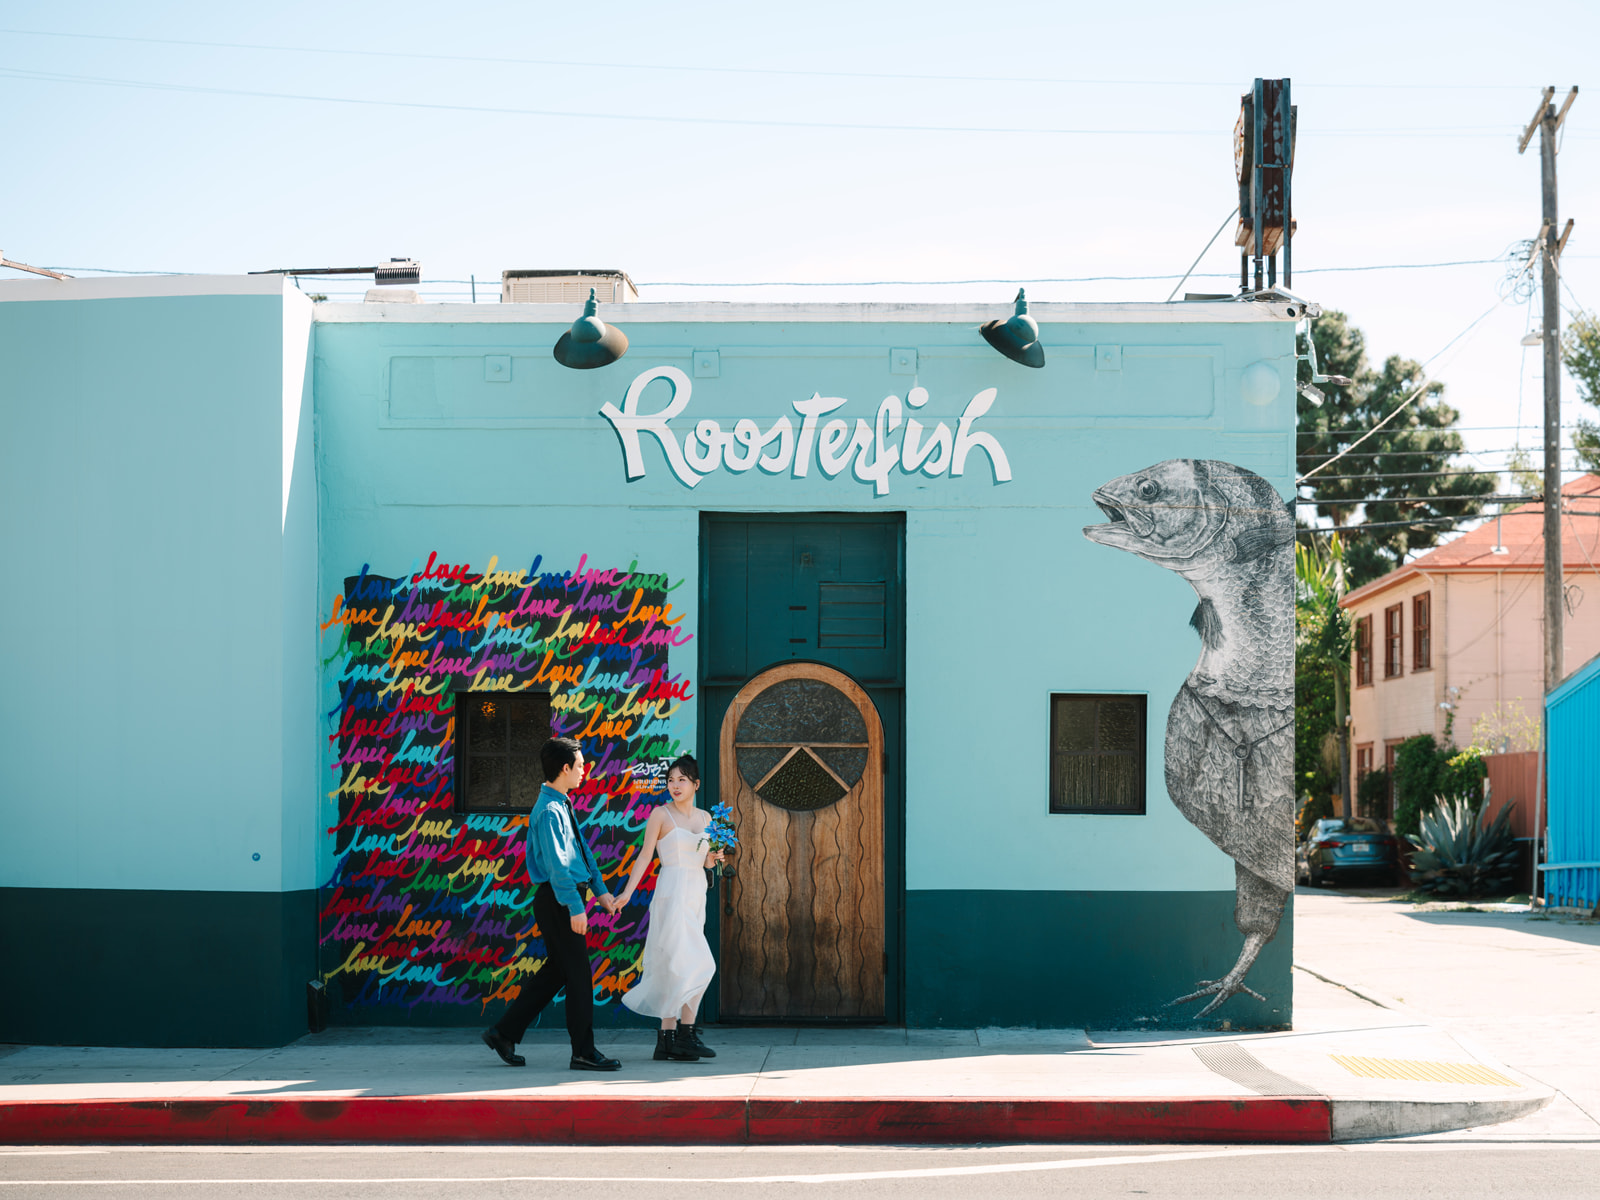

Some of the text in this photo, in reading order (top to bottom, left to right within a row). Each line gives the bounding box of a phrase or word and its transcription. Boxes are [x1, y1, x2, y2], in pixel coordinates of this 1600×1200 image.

[599, 365, 1012, 497] Roosterfish
[413, 551, 483, 583] love
[472, 555, 542, 590] love
[564, 553, 632, 588] love
[610, 559, 685, 595] love
[320, 594, 383, 630] love
[417, 600, 484, 632] love
[503, 586, 574, 619] love
[612, 588, 686, 630] love
[366, 605, 437, 643] love
[471, 614, 542, 651] love
[570, 615, 642, 652] love
[630, 614, 694, 649] love
[326, 651, 398, 688] love
[415, 641, 494, 676] love
[523, 649, 596, 688] love
[568, 656, 645, 694] love
[388, 683, 456, 717] love
[607, 683, 680, 719] love
[638, 669, 694, 704] love
[329, 705, 402, 740] love
[574, 703, 641, 740] love
[627, 706, 693, 742] love
[390, 729, 454, 765] love
[364, 753, 440, 788] love
[328, 794, 408, 832] love
[396, 801, 460, 840] love
[579, 793, 650, 831] love
[335, 823, 408, 861] love
[438, 824, 508, 861] love
[352, 848, 422, 881] love
[400, 857, 477, 894] love
[321, 887, 384, 917] love
[461, 873, 535, 910] love
[390, 904, 450, 939] love
[359, 925, 428, 962] love
[379, 947, 456, 986] love
